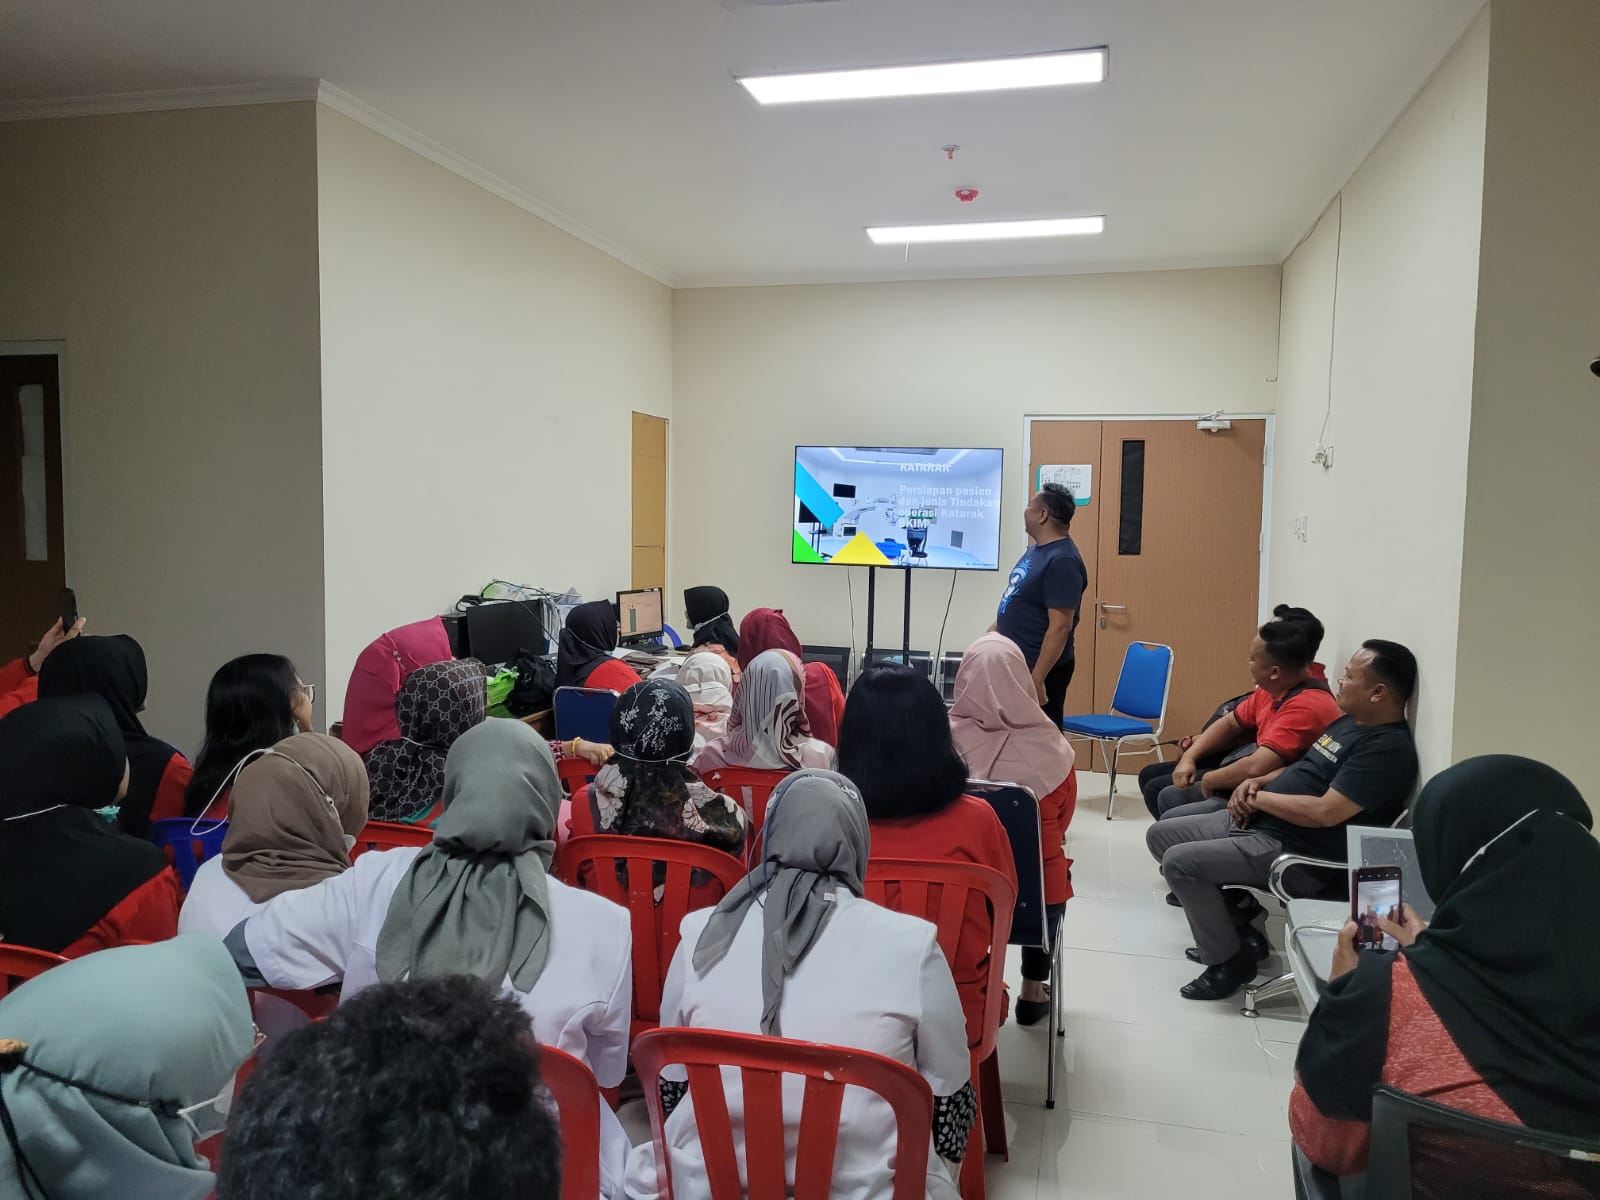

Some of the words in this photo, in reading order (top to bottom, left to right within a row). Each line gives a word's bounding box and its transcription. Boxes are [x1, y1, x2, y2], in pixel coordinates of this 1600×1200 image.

[899, 485, 952, 497] Persiapan
[956, 486, 992, 497] pasien
[921, 497, 947, 508] jenis
[950, 497, 1000, 508] Tindakan
[940, 508, 984, 519] Katarak
